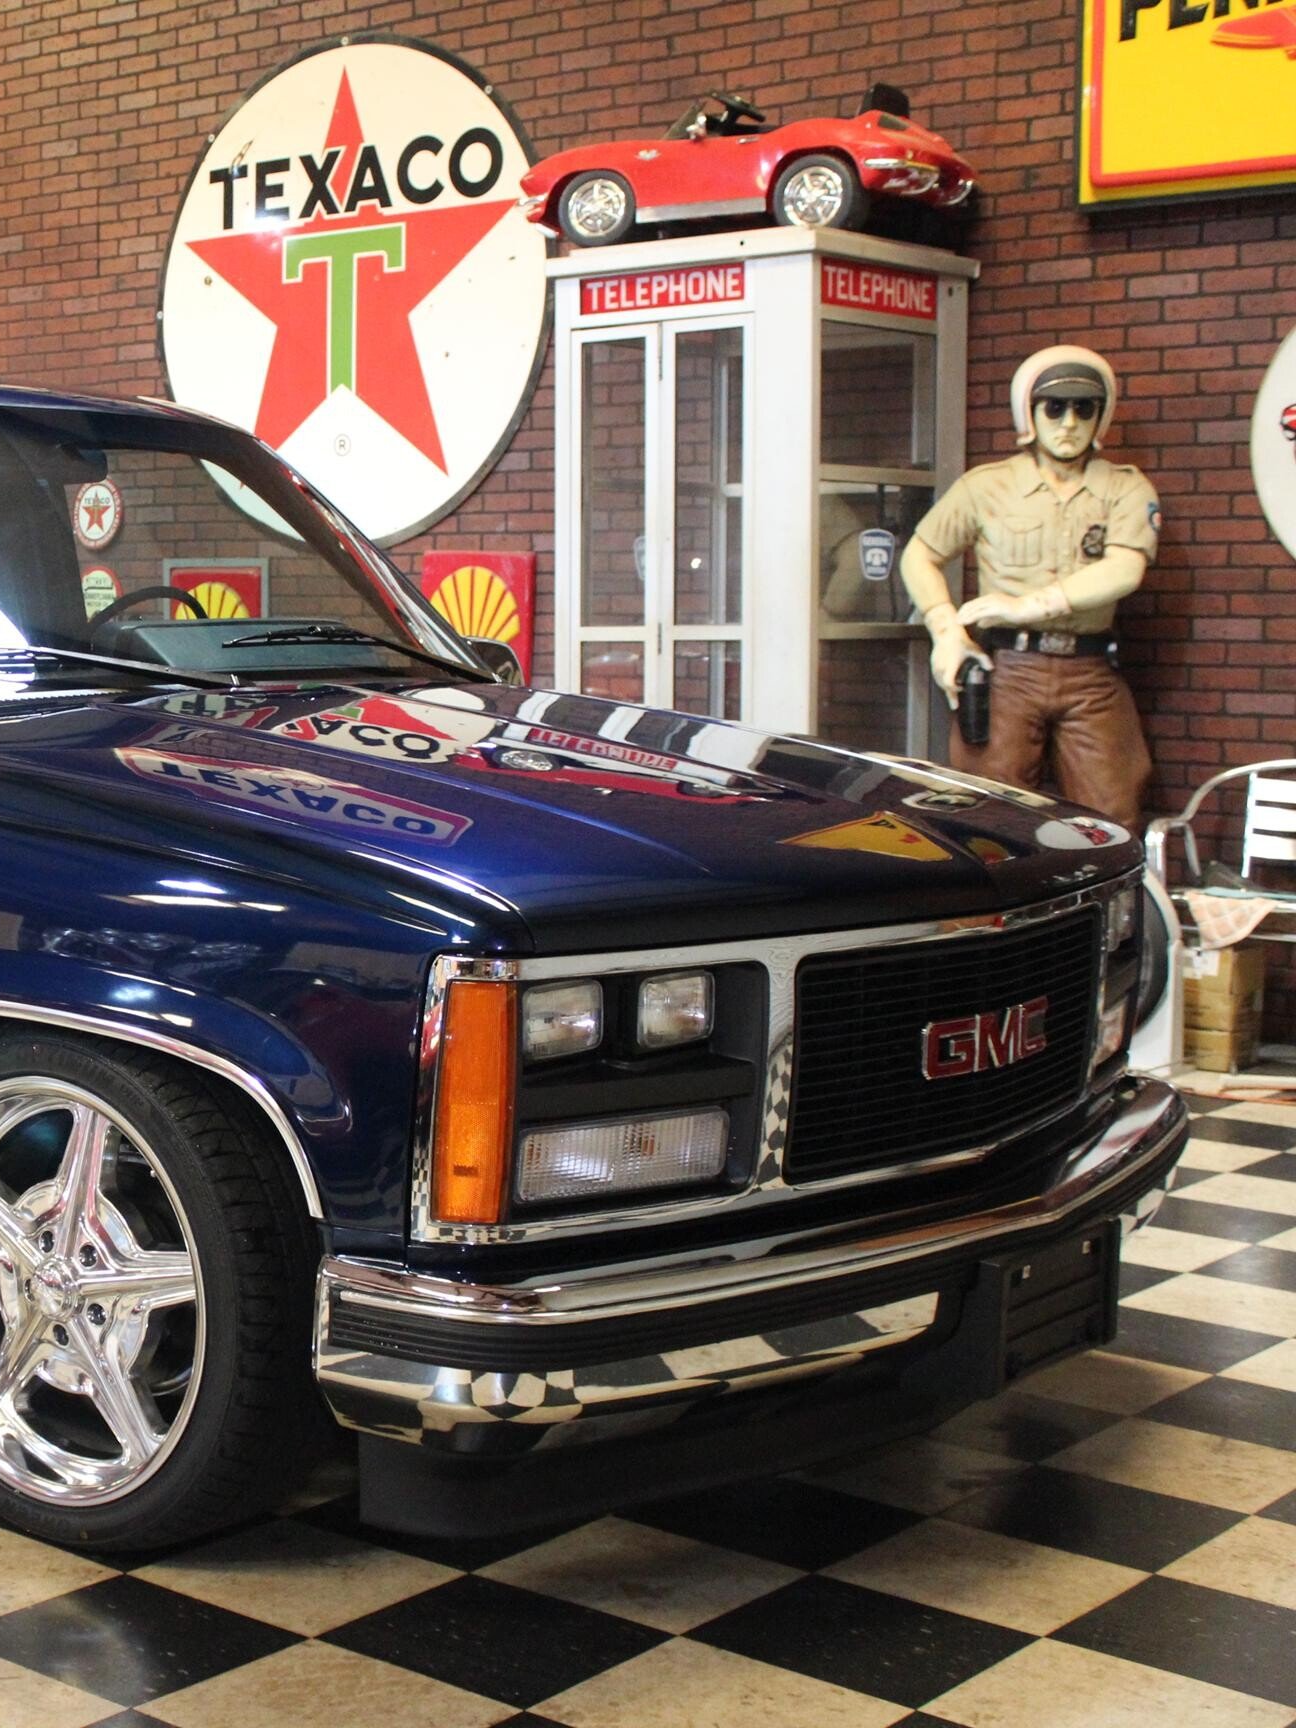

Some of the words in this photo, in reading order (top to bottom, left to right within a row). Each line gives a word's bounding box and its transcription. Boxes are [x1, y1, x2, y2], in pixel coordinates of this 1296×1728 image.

[209, 127, 504, 230] TEXACO
[281, 222, 406, 395] T
[586, 266, 742, 312] TELEPHONE
[824, 264, 932, 313] TELEPHONE
[84, 496, 111, 505] TECO
[921, 995, 1049, 1080] GMC
